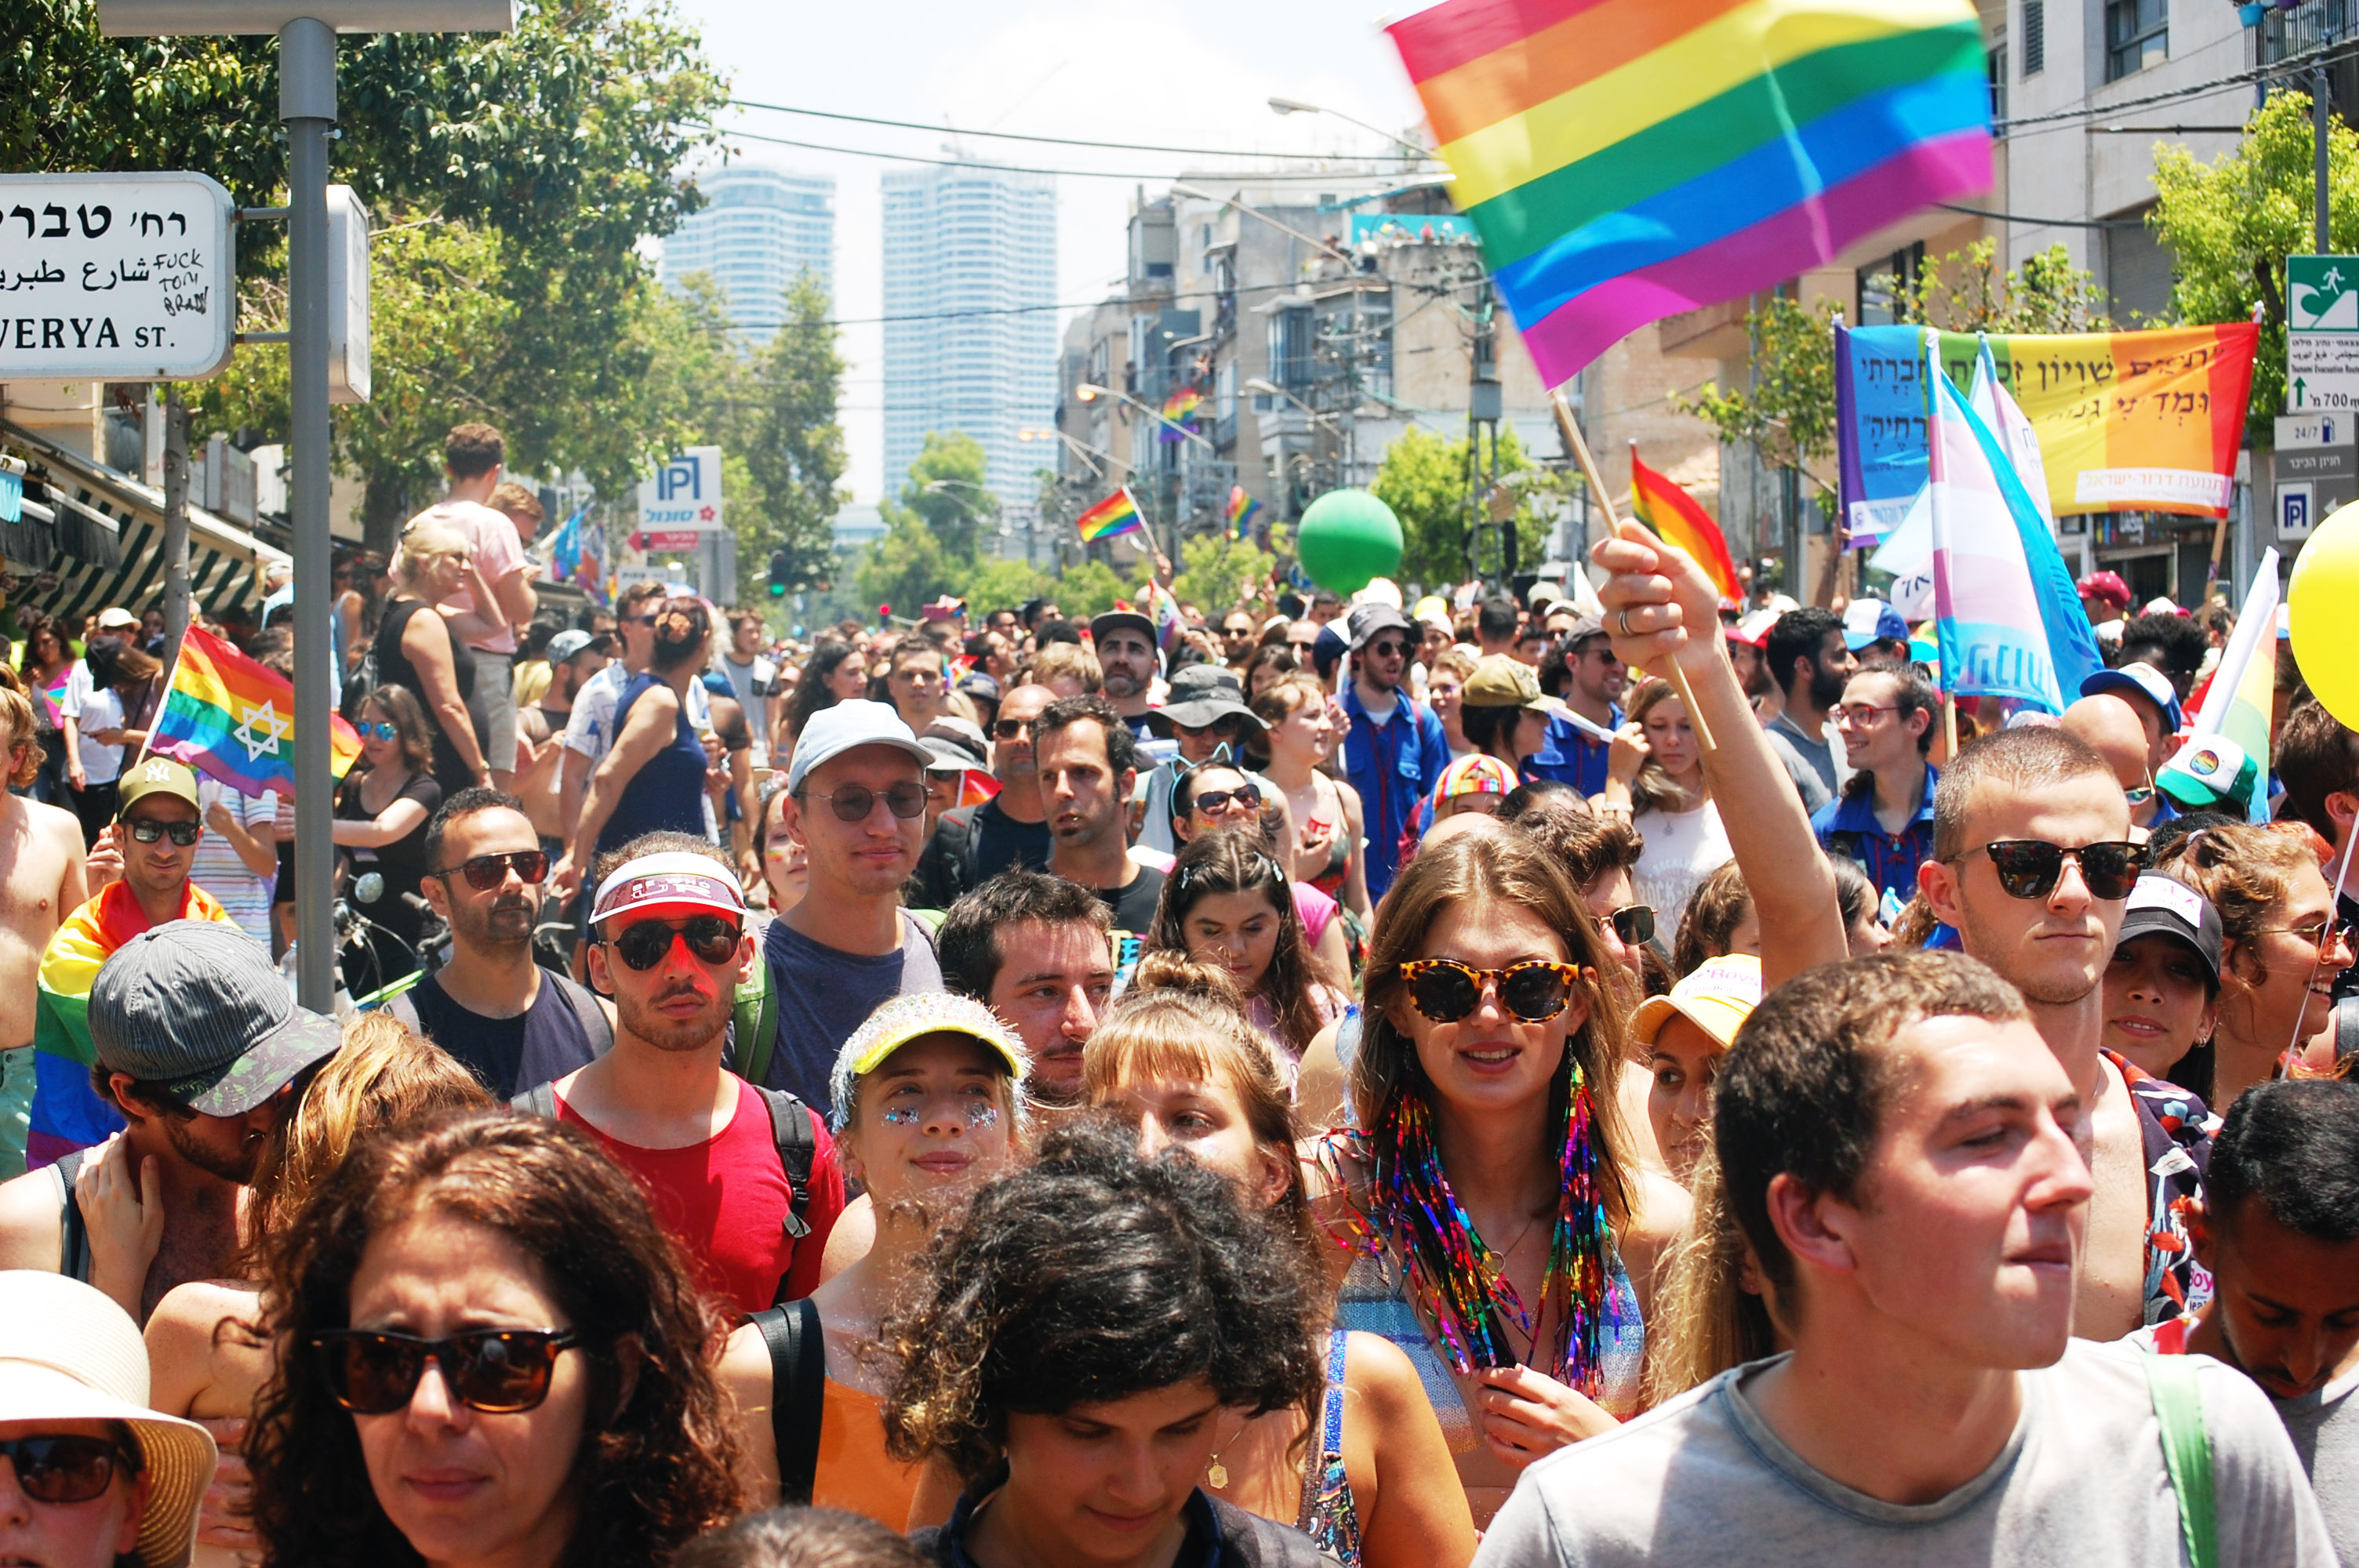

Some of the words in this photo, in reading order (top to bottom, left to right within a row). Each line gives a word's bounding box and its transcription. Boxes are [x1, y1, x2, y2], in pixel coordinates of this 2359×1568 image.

[153, 248, 205, 270] FUCK
[82, 258, 150, 292] شارع
[135, 326, 176, 347] ST.
[2323, 393, 2348, 407] 700
[2295, 426, 2318, 440] 24/7
[645, 509, 694, 523] סונול
[665, 877, 711, 889] WHO
